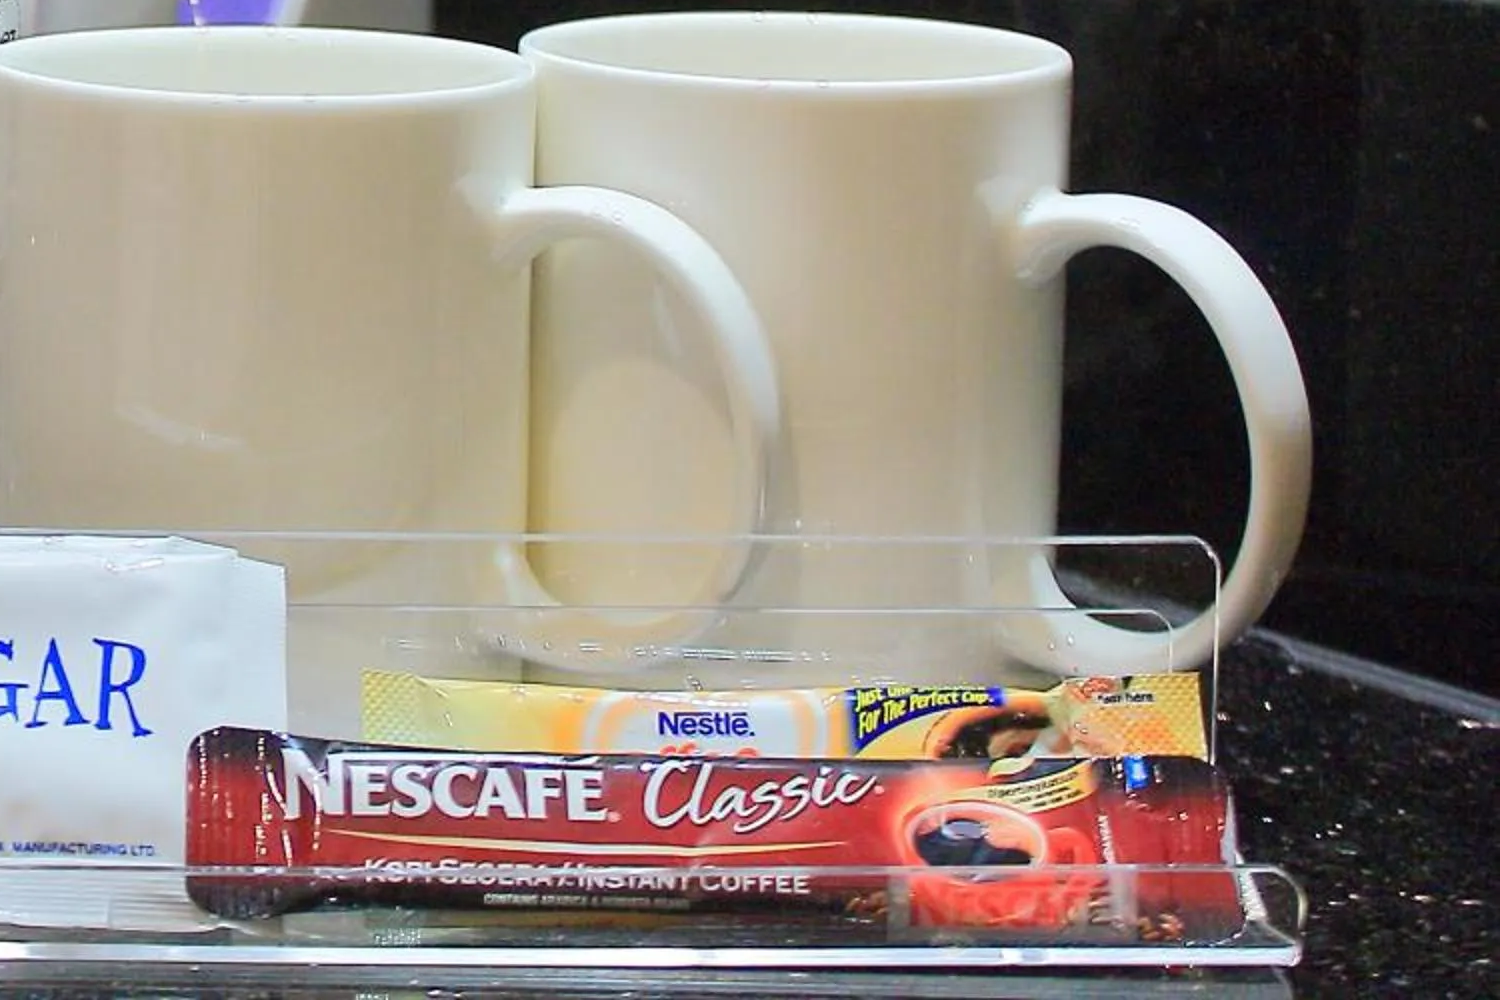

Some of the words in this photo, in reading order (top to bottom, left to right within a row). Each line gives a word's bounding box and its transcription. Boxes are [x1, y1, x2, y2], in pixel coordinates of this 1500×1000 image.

[858, 708, 882, 740] For
[882, 699, 908, 725] The
[908, 690, 960, 713] Perfect
[642, 760, 875, 832] Classic
[11, 842, 128, 857] MANUFACTURING
[699, 865, 811, 894] COFFEE
